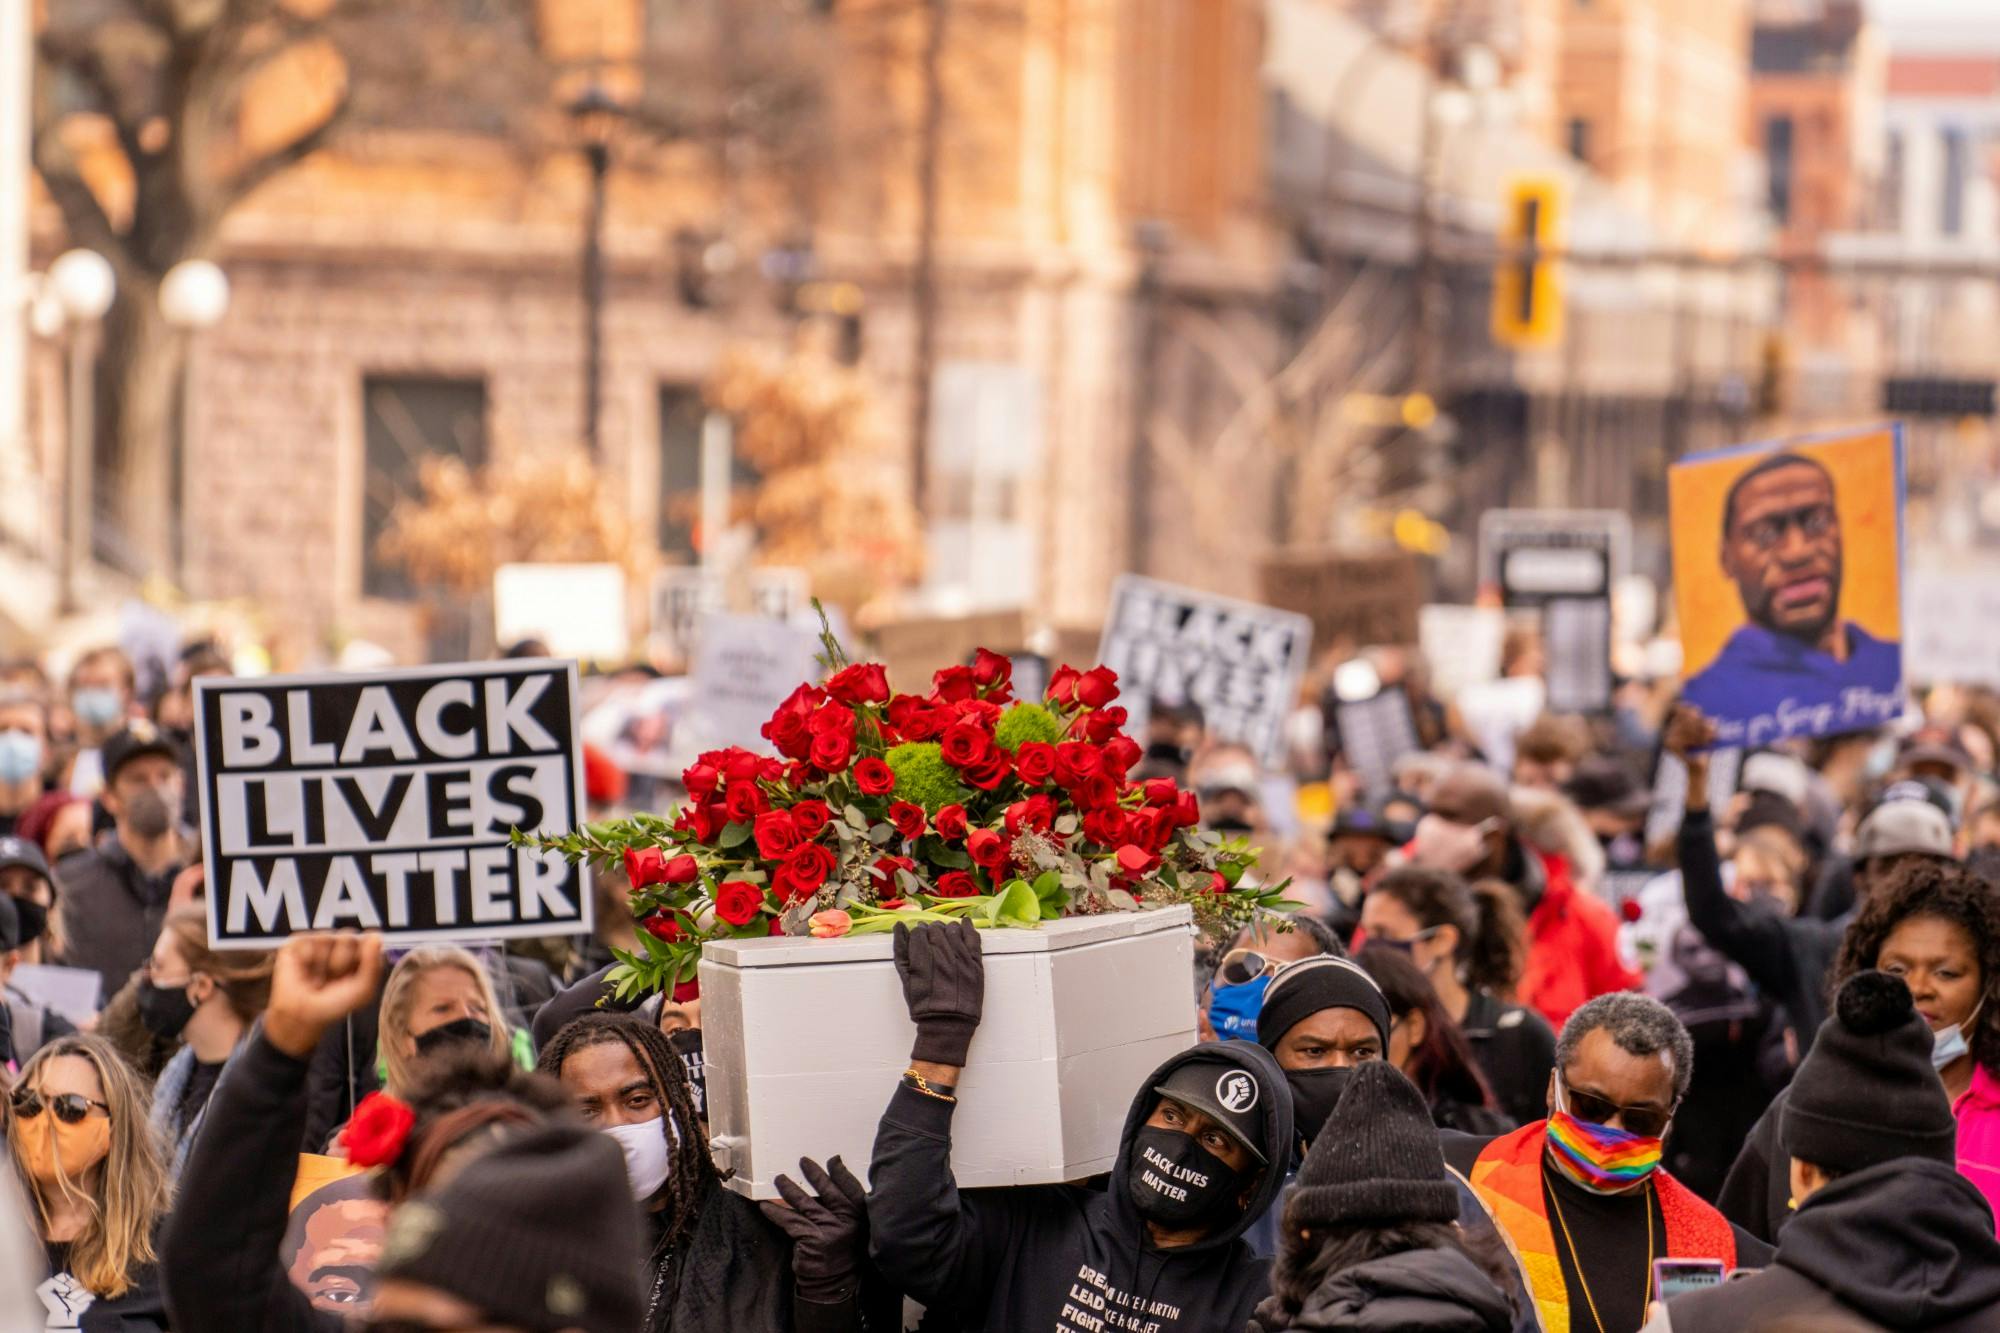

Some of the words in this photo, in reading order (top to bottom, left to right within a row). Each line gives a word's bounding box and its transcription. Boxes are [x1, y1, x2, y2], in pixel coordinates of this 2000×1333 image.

[219, 673, 560, 768] BLACK
[243, 764, 544, 847] LIVES
[225, 847, 578, 934] MATTER
[1141, 1169, 1187, 1202] MATTER
[1143, 1146, 1175, 1175] BLACK
[1172, 1165, 1209, 1188] LIVES
[1061, 1303, 1104, 1333] FIGHT
[1069, 1283, 1105, 1311] LEAD
